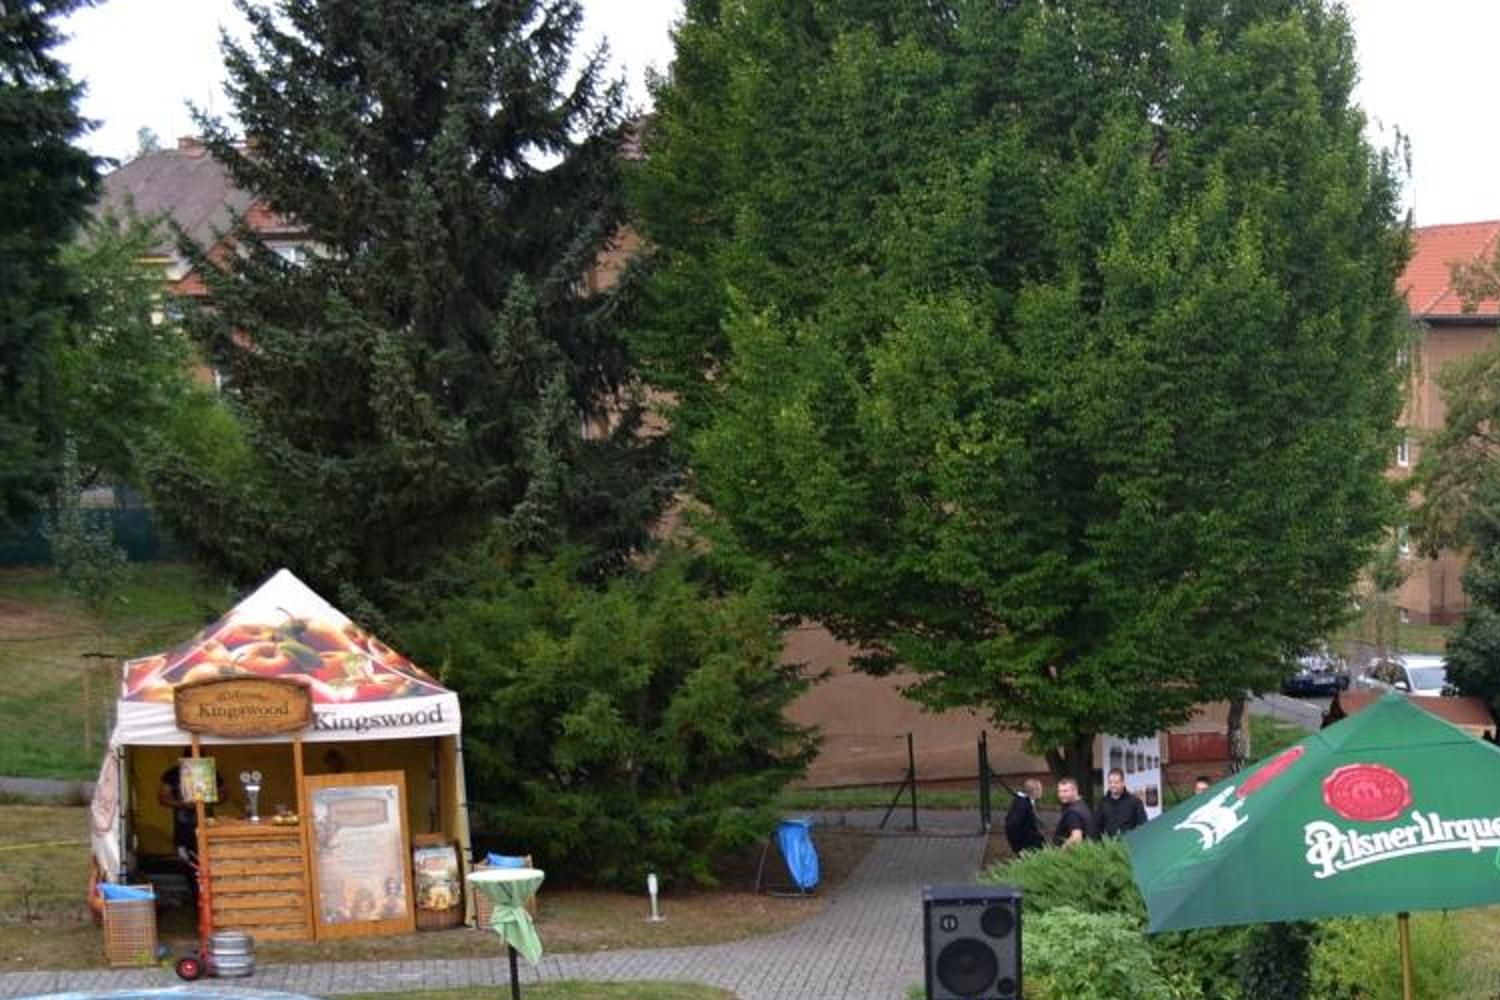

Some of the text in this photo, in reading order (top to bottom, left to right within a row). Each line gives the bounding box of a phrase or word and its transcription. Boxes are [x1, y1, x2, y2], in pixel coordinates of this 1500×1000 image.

[199, 700, 289, 719] Kingswood
[313, 704, 444, 732] Kingswood
[1305, 814, 1417, 879] Pilsner
